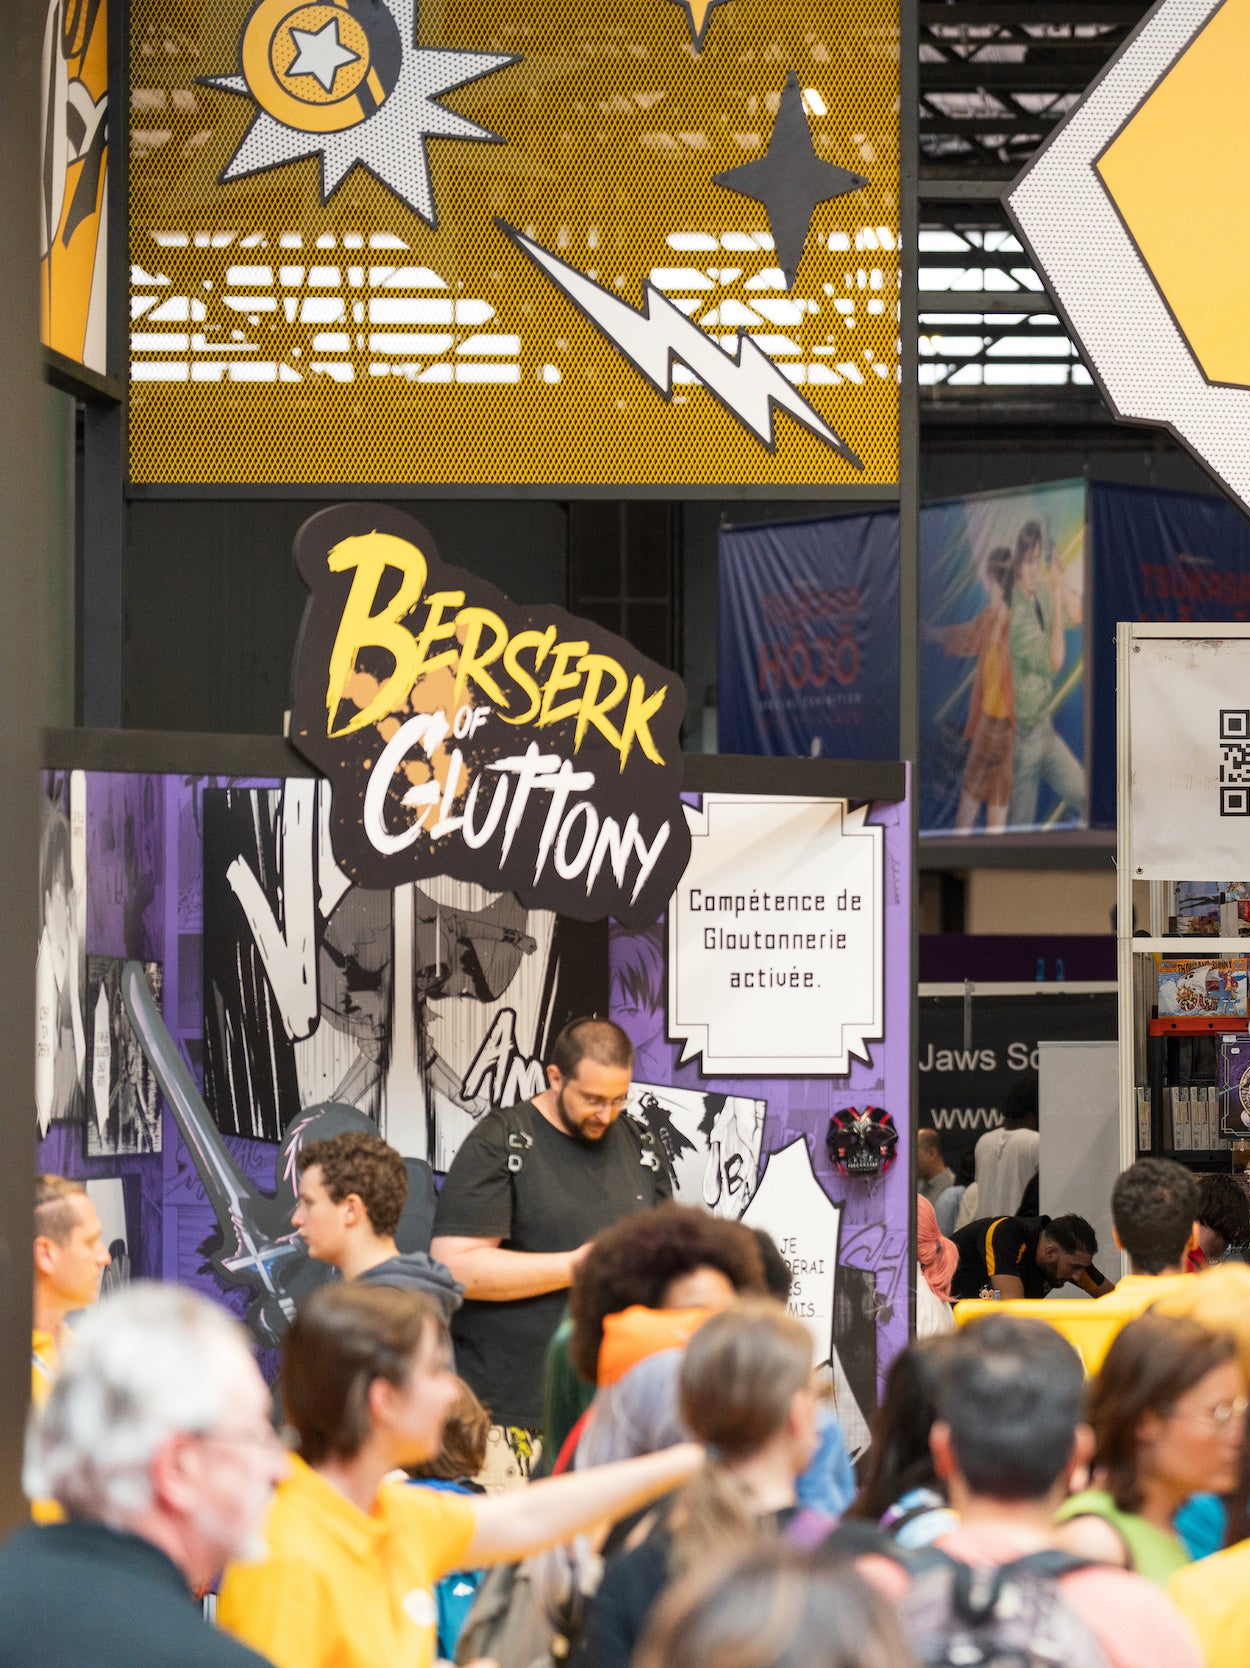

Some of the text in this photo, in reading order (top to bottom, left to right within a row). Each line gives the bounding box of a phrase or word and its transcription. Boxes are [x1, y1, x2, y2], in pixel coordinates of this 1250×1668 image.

[325, 529, 668, 774] BERSERK
[453, 705, 491, 740] OF
[363, 706, 671, 906] GLUTTONY
[689, 888, 862, 918] Compétence de
[704, 927, 847, 950] Gloutonnerie
[730, 965, 821, 988] activée.
[918, 1043, 998, 1071] Jaws
[780, 1237, 797, 1254] JE
